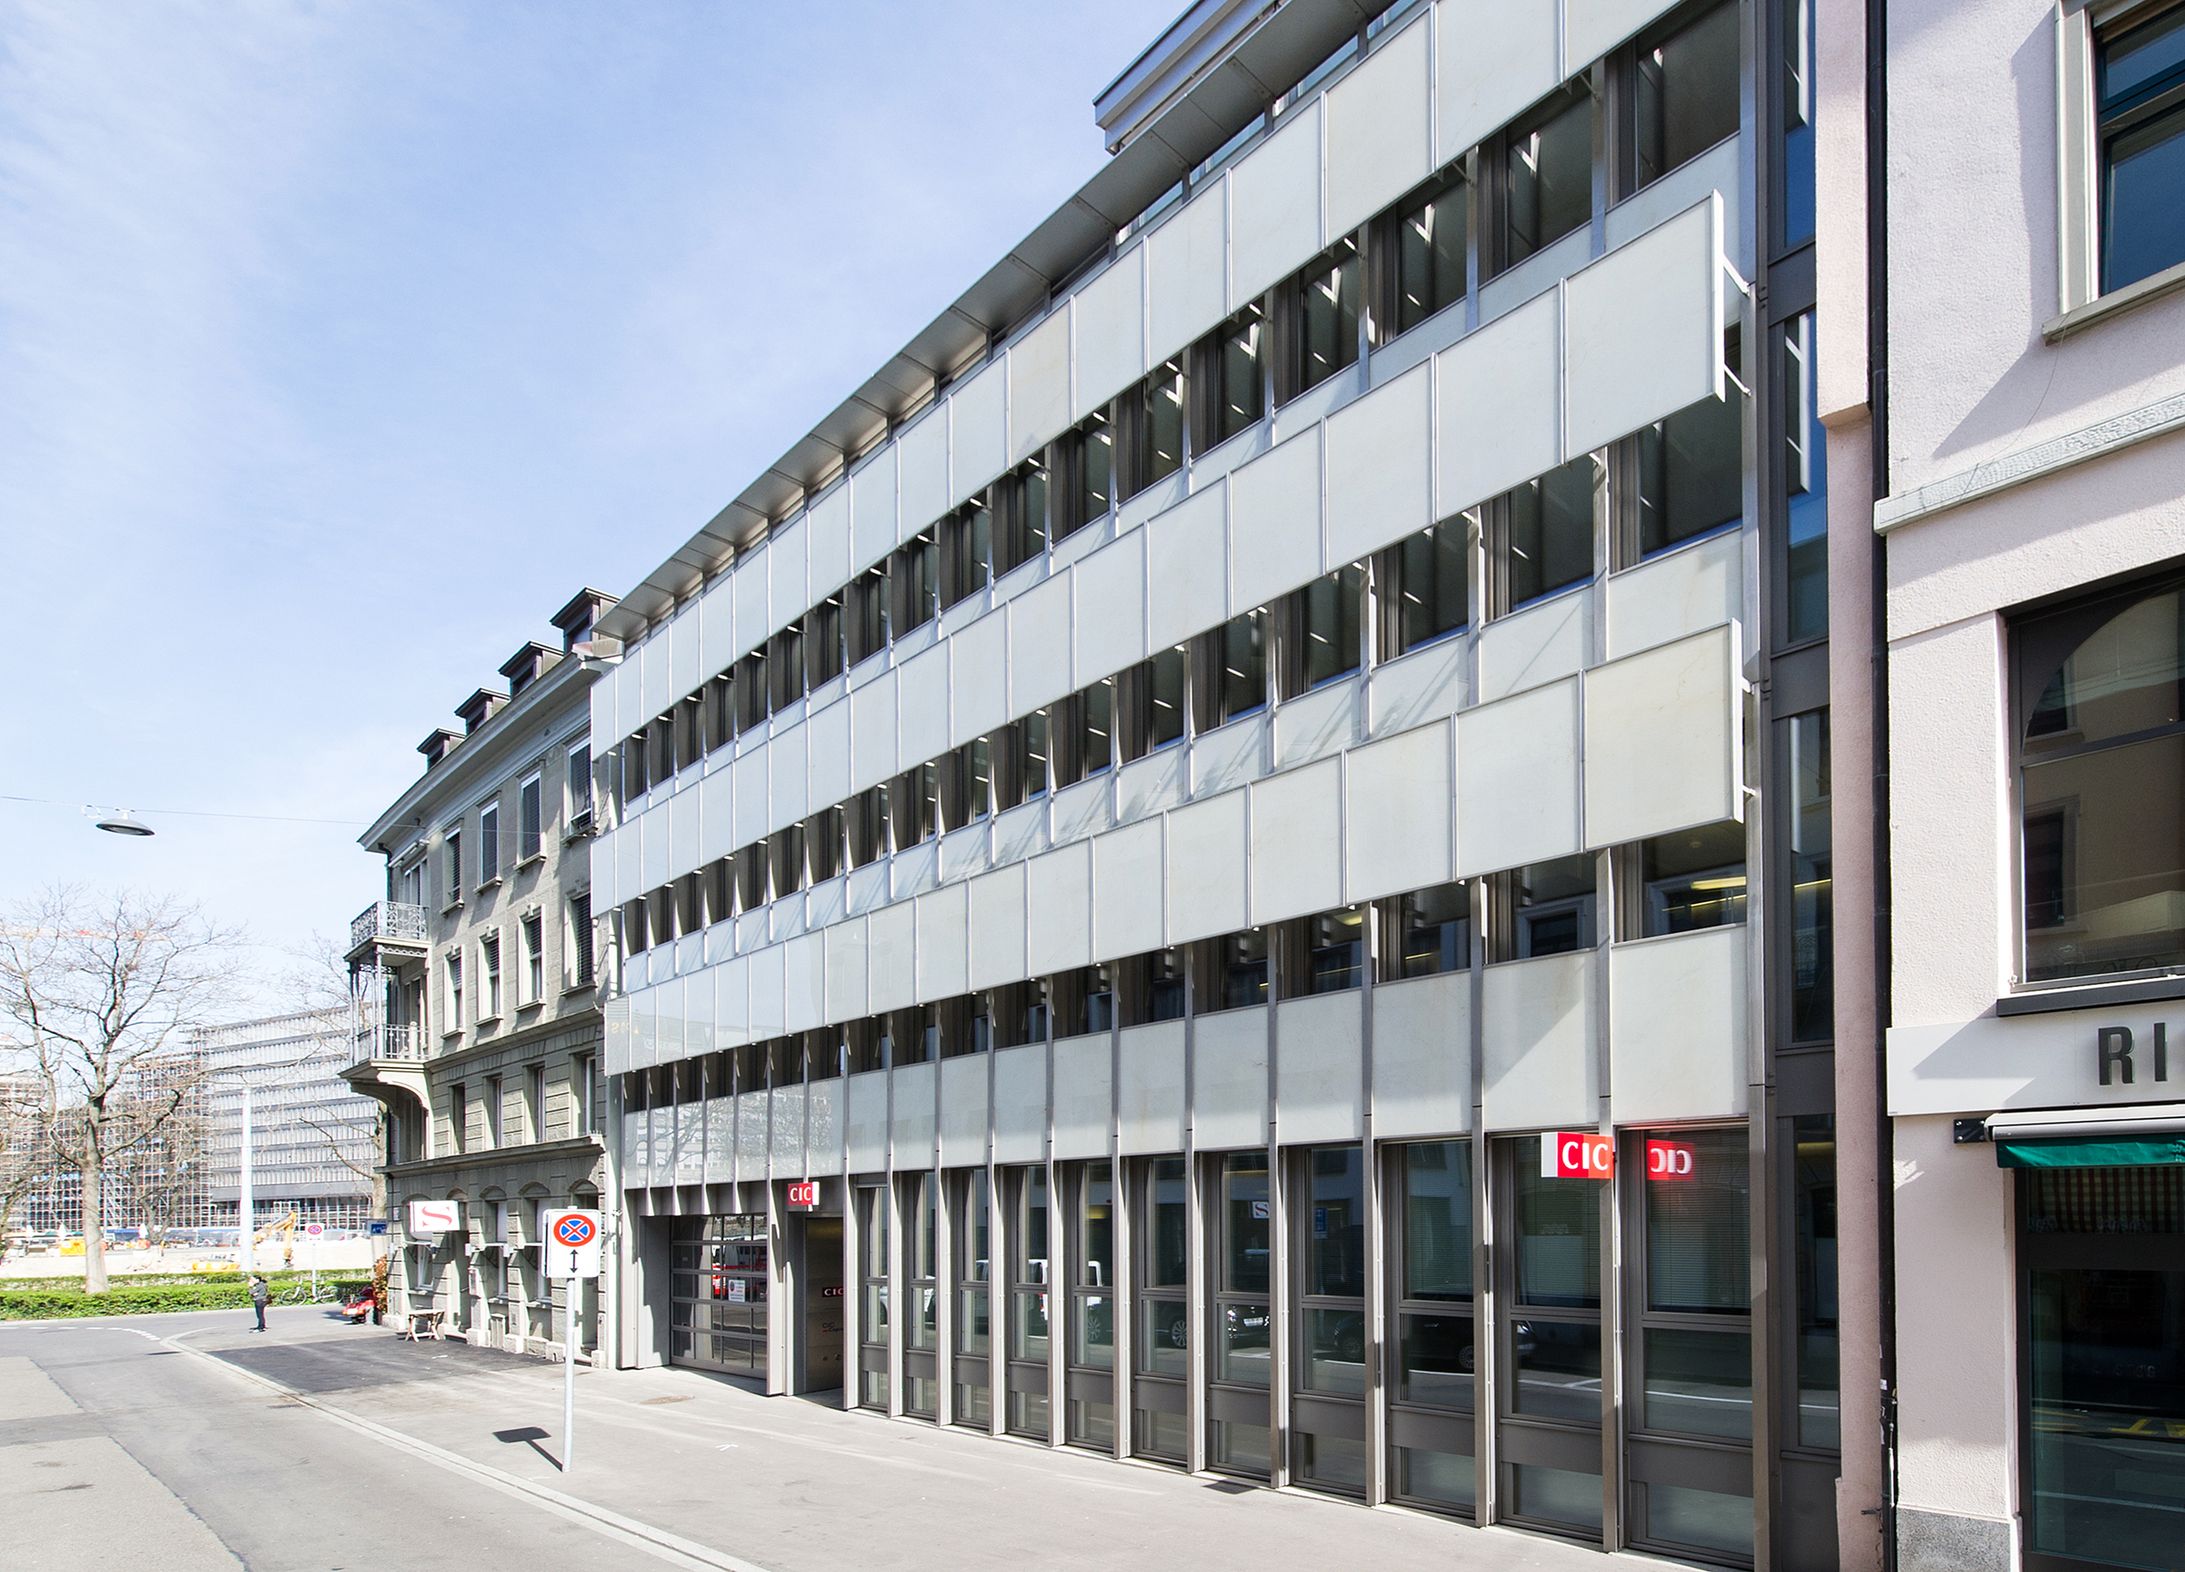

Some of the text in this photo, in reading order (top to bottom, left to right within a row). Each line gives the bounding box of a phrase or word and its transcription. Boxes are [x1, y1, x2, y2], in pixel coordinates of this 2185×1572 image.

[2098, 1022, 2168, 1085] RI
[1562, 1141, 1609, 1171] CIC
[790, 1186, 812, 1202] CIC
